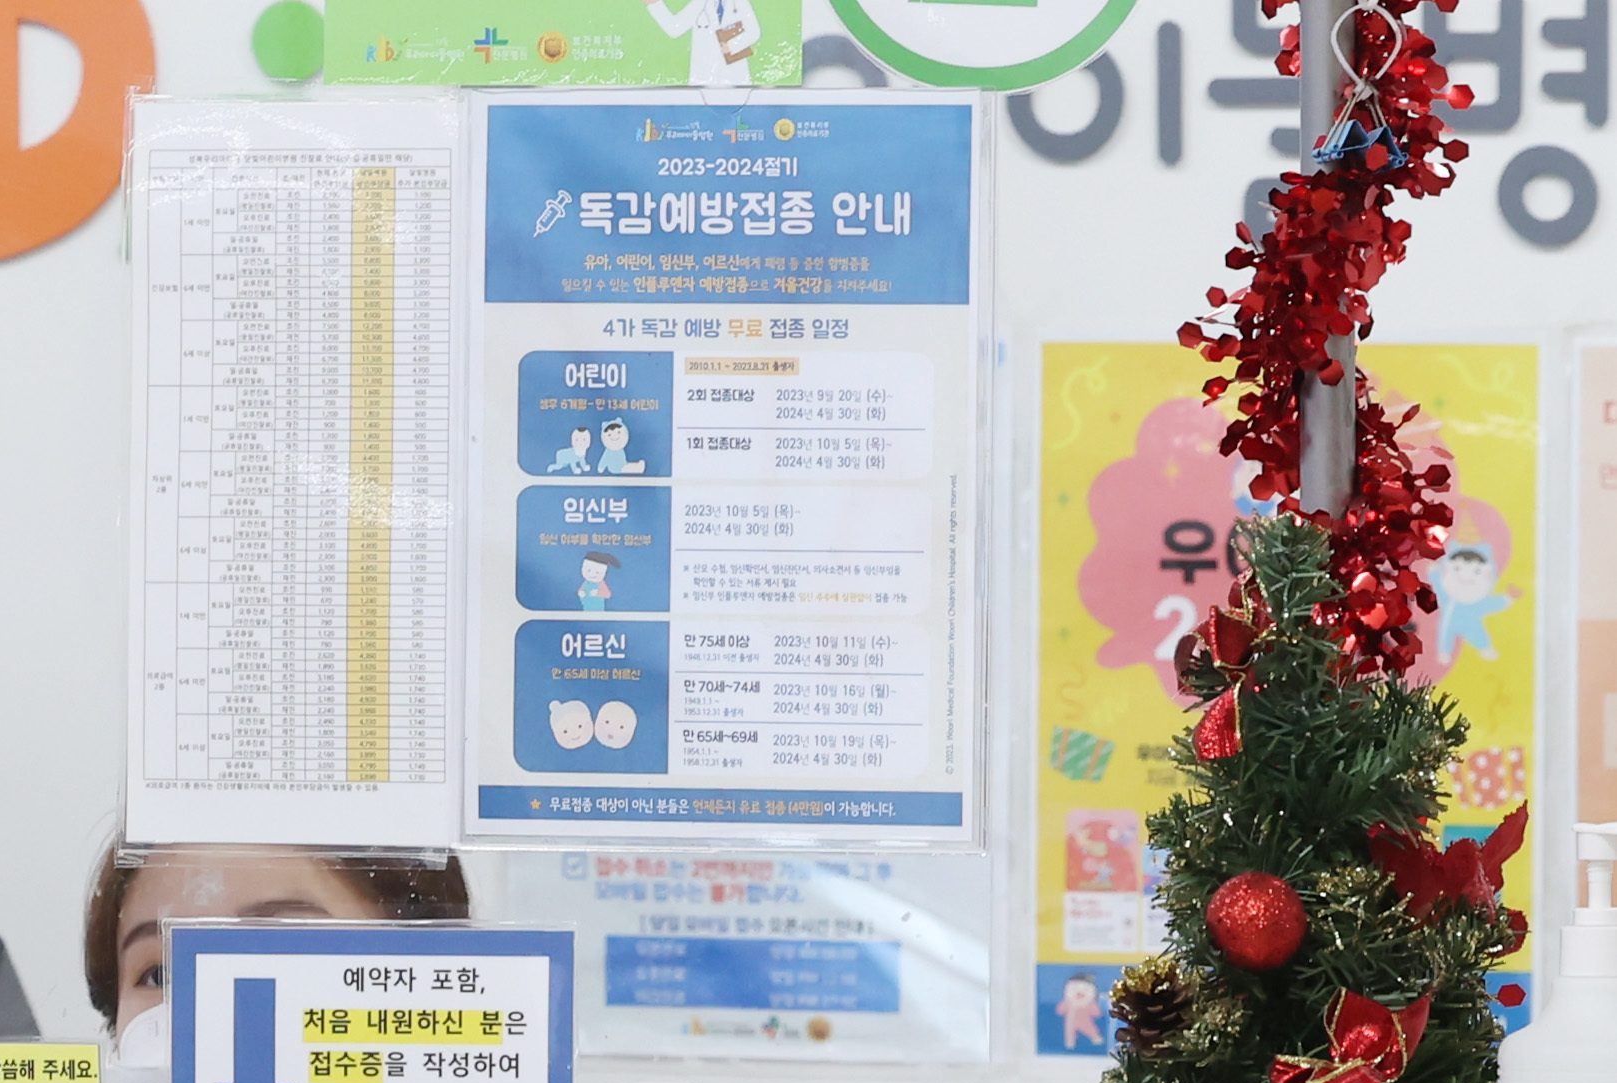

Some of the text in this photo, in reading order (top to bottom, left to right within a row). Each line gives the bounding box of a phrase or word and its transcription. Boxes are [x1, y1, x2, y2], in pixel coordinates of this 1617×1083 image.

[658, 157, 798, 177] 2023-2024절기
[579, 190, 912, 236] 독감예방접종 안내
[603, 318, 849, 339] 4가 독감 예방 무료 접종 일정
[564, 362, 626, 389] 어린이
[687, 389, 862, 402] 2회 접종대상 2023년 9월 20일
[776, 407, 887, 421] 2024년 4월 30일 (화)
[687, 437, 861, 450] 1회 접종대상 2023년 10월 5일
[775, 455, 885, 470] 2024년 4월 30일 (화)
[563, 498, 628, 523] 임신부
[685, 505, 770, 517] 2023년 10월 5일
[685, 522, 794, 537] 2024년 4월 30일 (화)
[561, 633, 626, 659] 어르신
[684, 634, 867, 648] 만 75세 이상 2023년 10월 11일
[774, 653, 884, 667] 2024년 4월 30일 (화)
[684, 680, 866, 697] 만 70세~74세 2023년 10월 16일
[773, 702, 883, 717] 2024년 4월 30일 (화)
[683, 730, 865, 747] 만 65세~69세 2023년 10월 19일
[773, 752, 882, 767] 2024년 4월 30일 (화)
[550, 798, 896, 816] 무료접종 대상이 아닌 분들은 가능합니다.
[343, 967, 485, 994] 예약자 포함,
[304, 1009, 527, 1035] 처음 내원하신 분은
[43, 1060, 97, 1081] 주세요.
[310, 1051, 519, 1078] 접수증을 작성하여
